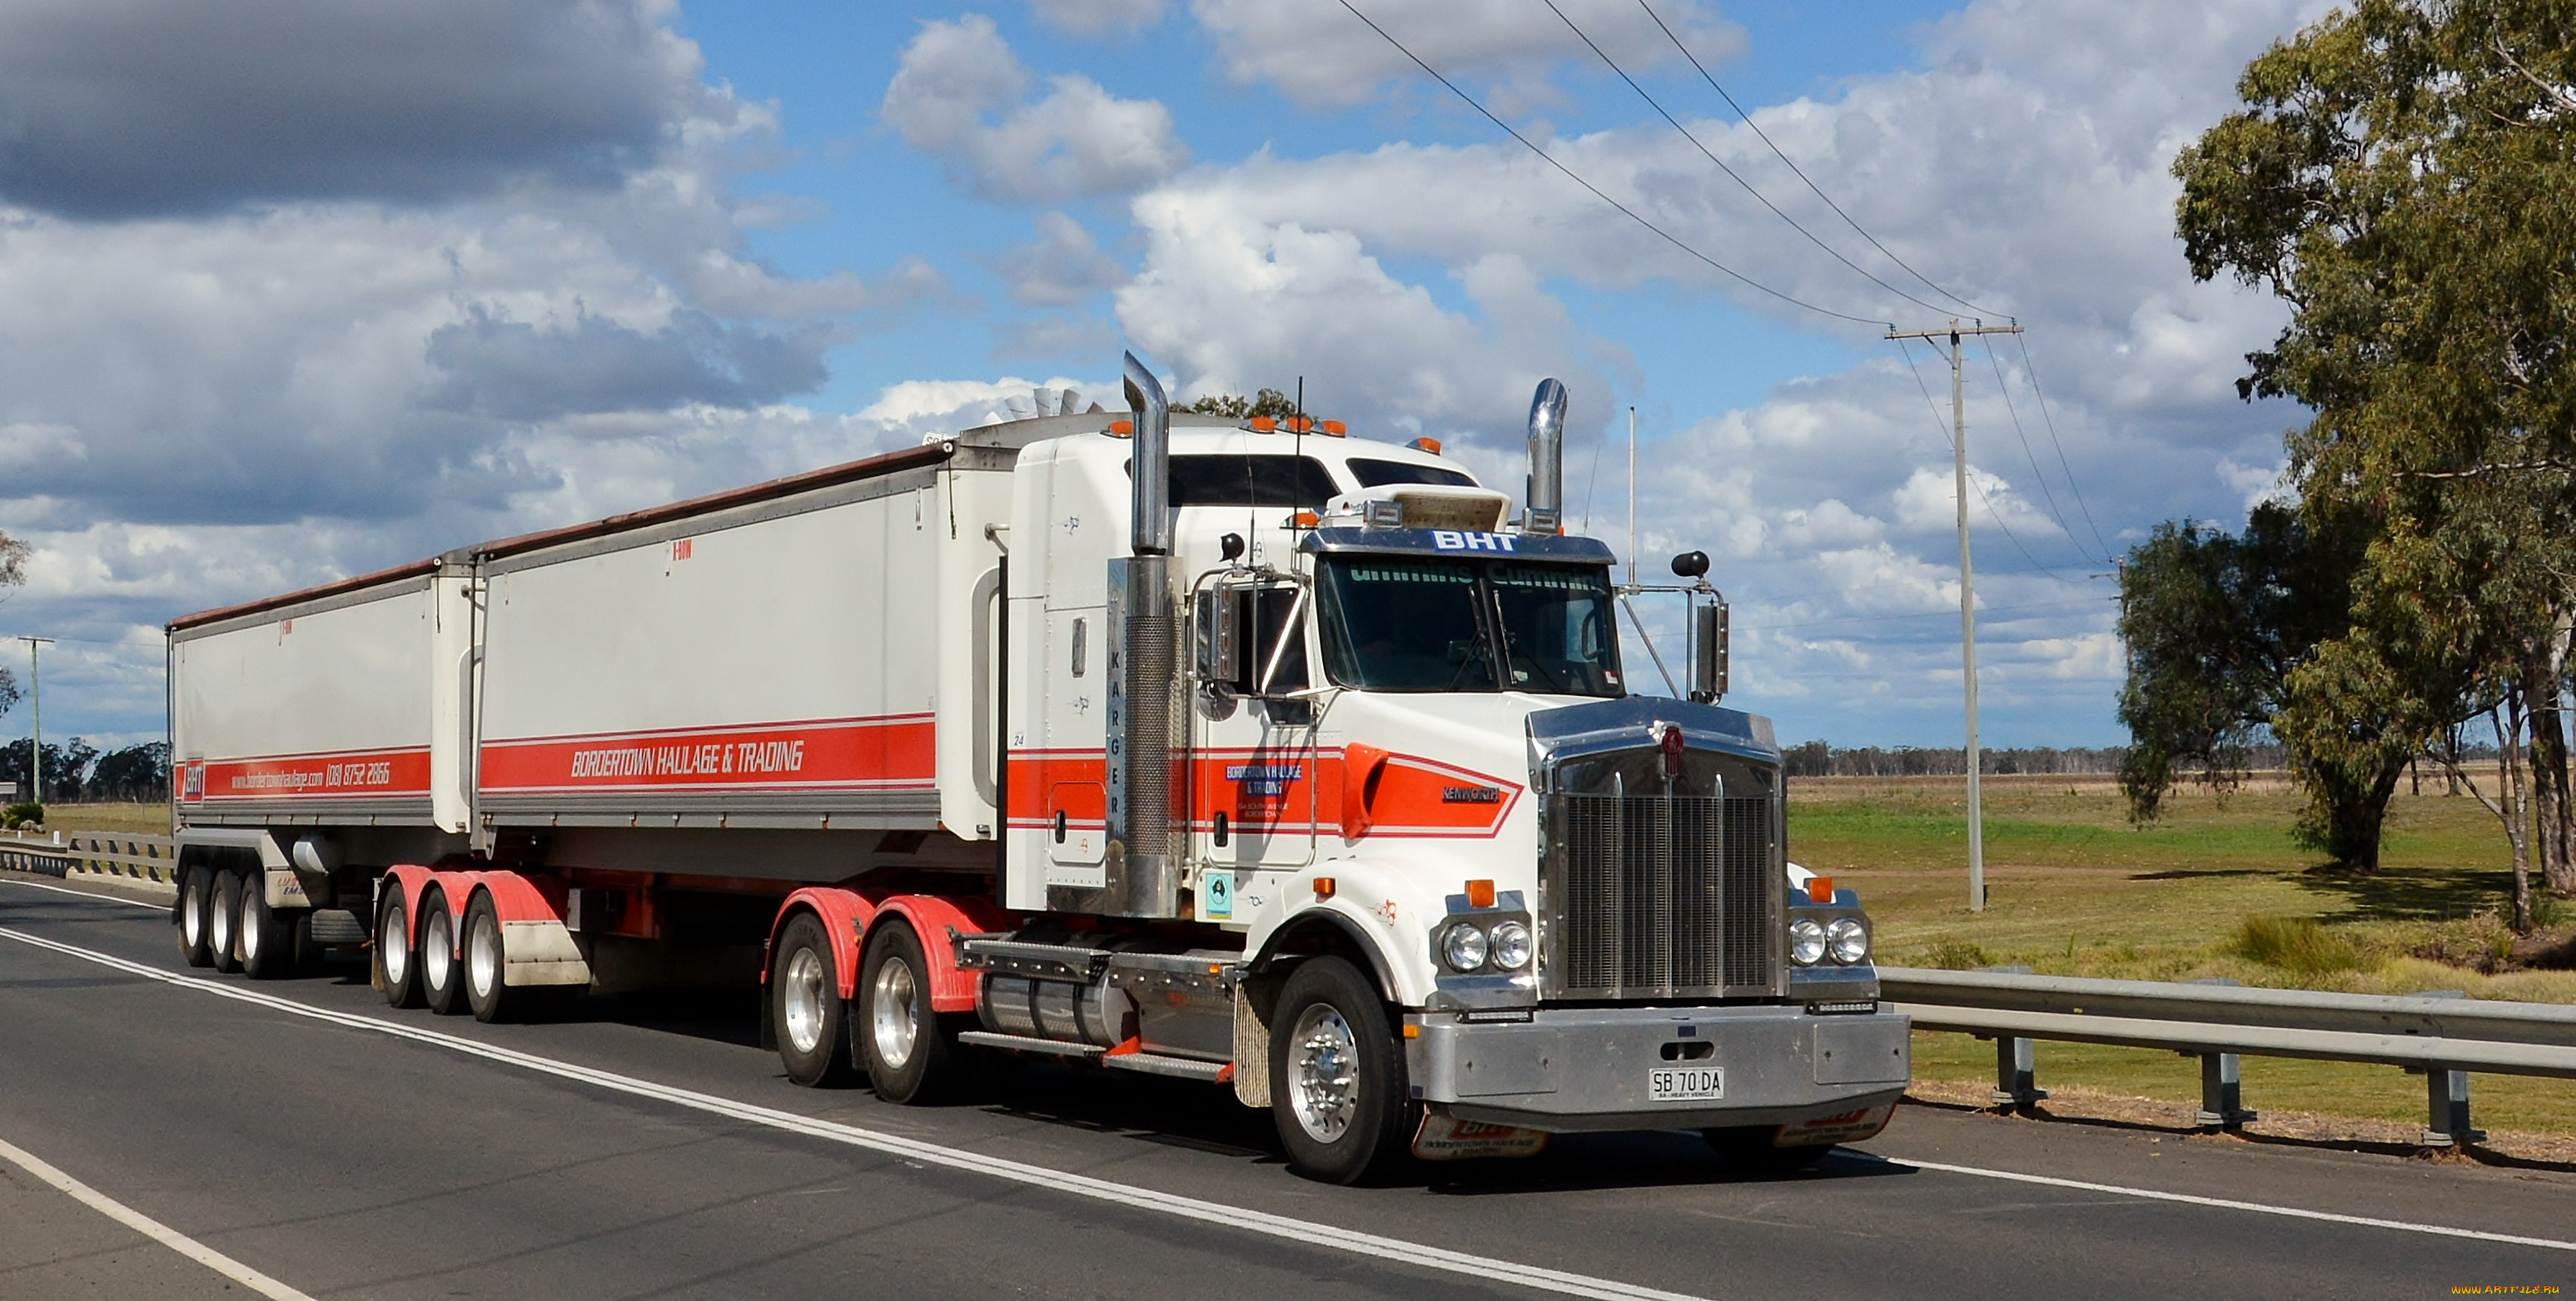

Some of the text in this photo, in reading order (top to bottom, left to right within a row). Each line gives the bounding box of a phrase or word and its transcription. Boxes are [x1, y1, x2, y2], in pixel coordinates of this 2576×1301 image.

[1431, 530, 1517, 551] BHT
[1350, 561, 1474, 584] ummins
[1014, 735, 1024, 746] 24
[1111, 651, 1120, 814] KARGER
[571, 740, 804, 777] BORDERTOWN HAULAGE & TRADING
[186, 765, 203, 793] BHT
[231, 762, 390, 792] www.bordertownhaulage.com (08) 8752 2866
[1226, 765, 1301, 778] BORDERTOWN HAULAGE
[1247, 781, 1281, 794] & TRADING
[1443, 787, 1499, 801] KENWORTH
[1654, 1071, 1720, 1092] SB 70 DA
